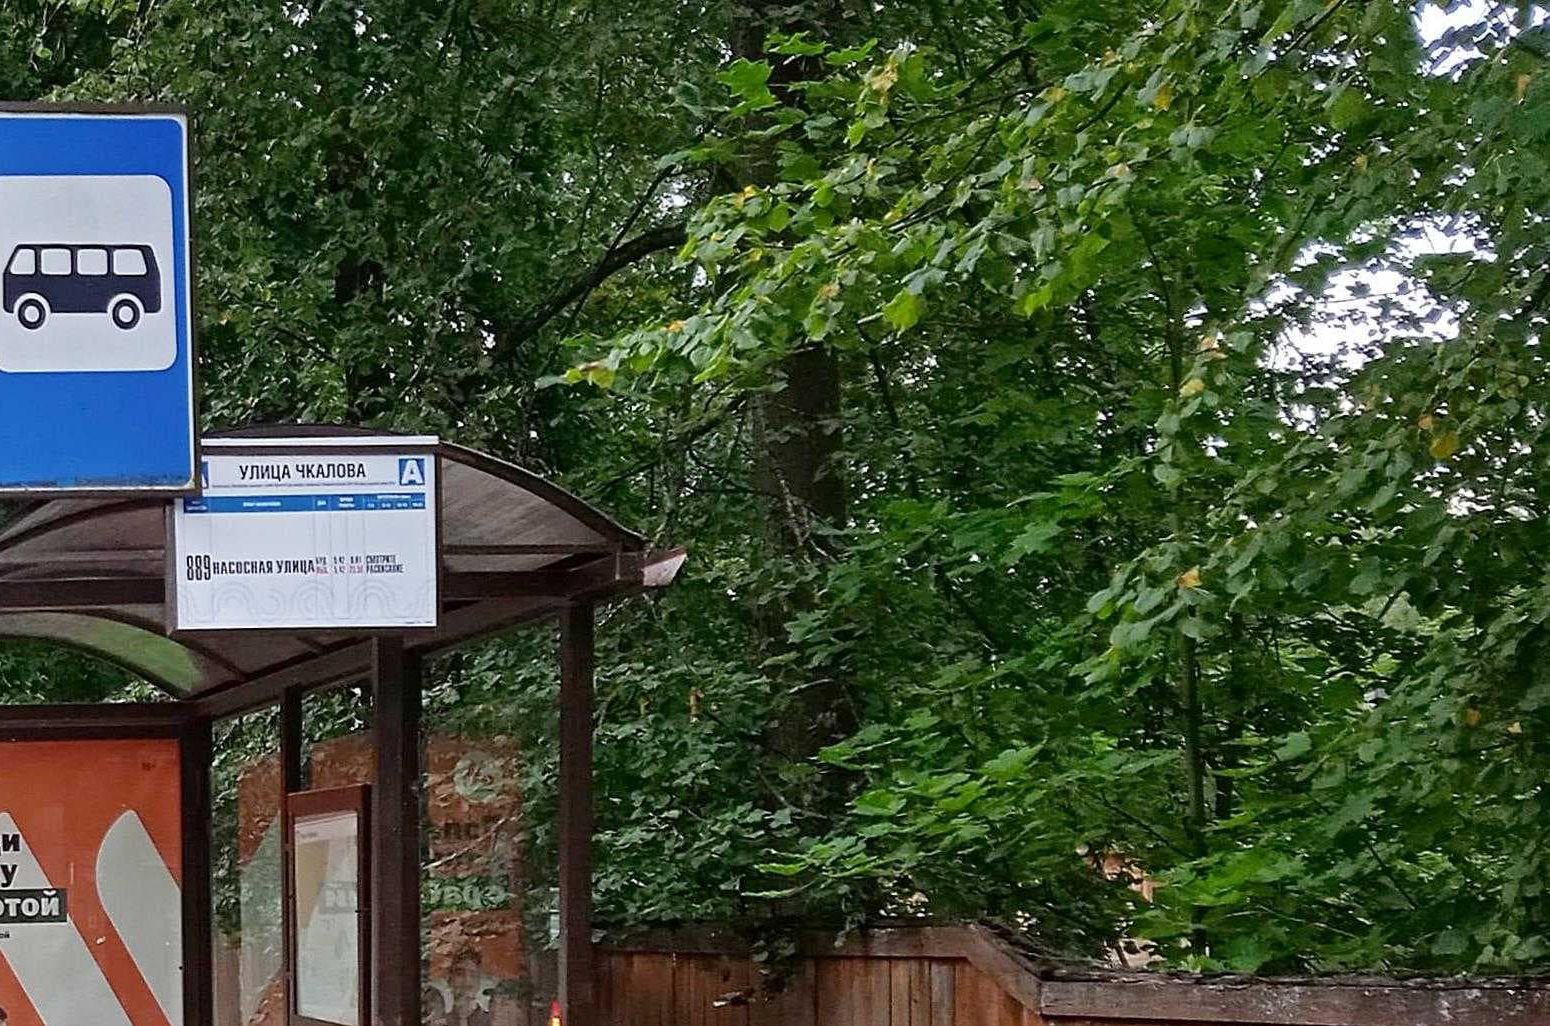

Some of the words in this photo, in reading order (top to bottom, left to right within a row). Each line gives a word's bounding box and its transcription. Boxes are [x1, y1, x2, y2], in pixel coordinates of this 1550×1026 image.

[239, 464, 291, 481] УЛИЦА
[296, 463, 366, 479] ЧКАЛОВА
[186, 554, 211, 581] 889
[212, 560, 274, 575] НАСОСНАЯ
[275, 559, 315, 575] УЛИЦА
